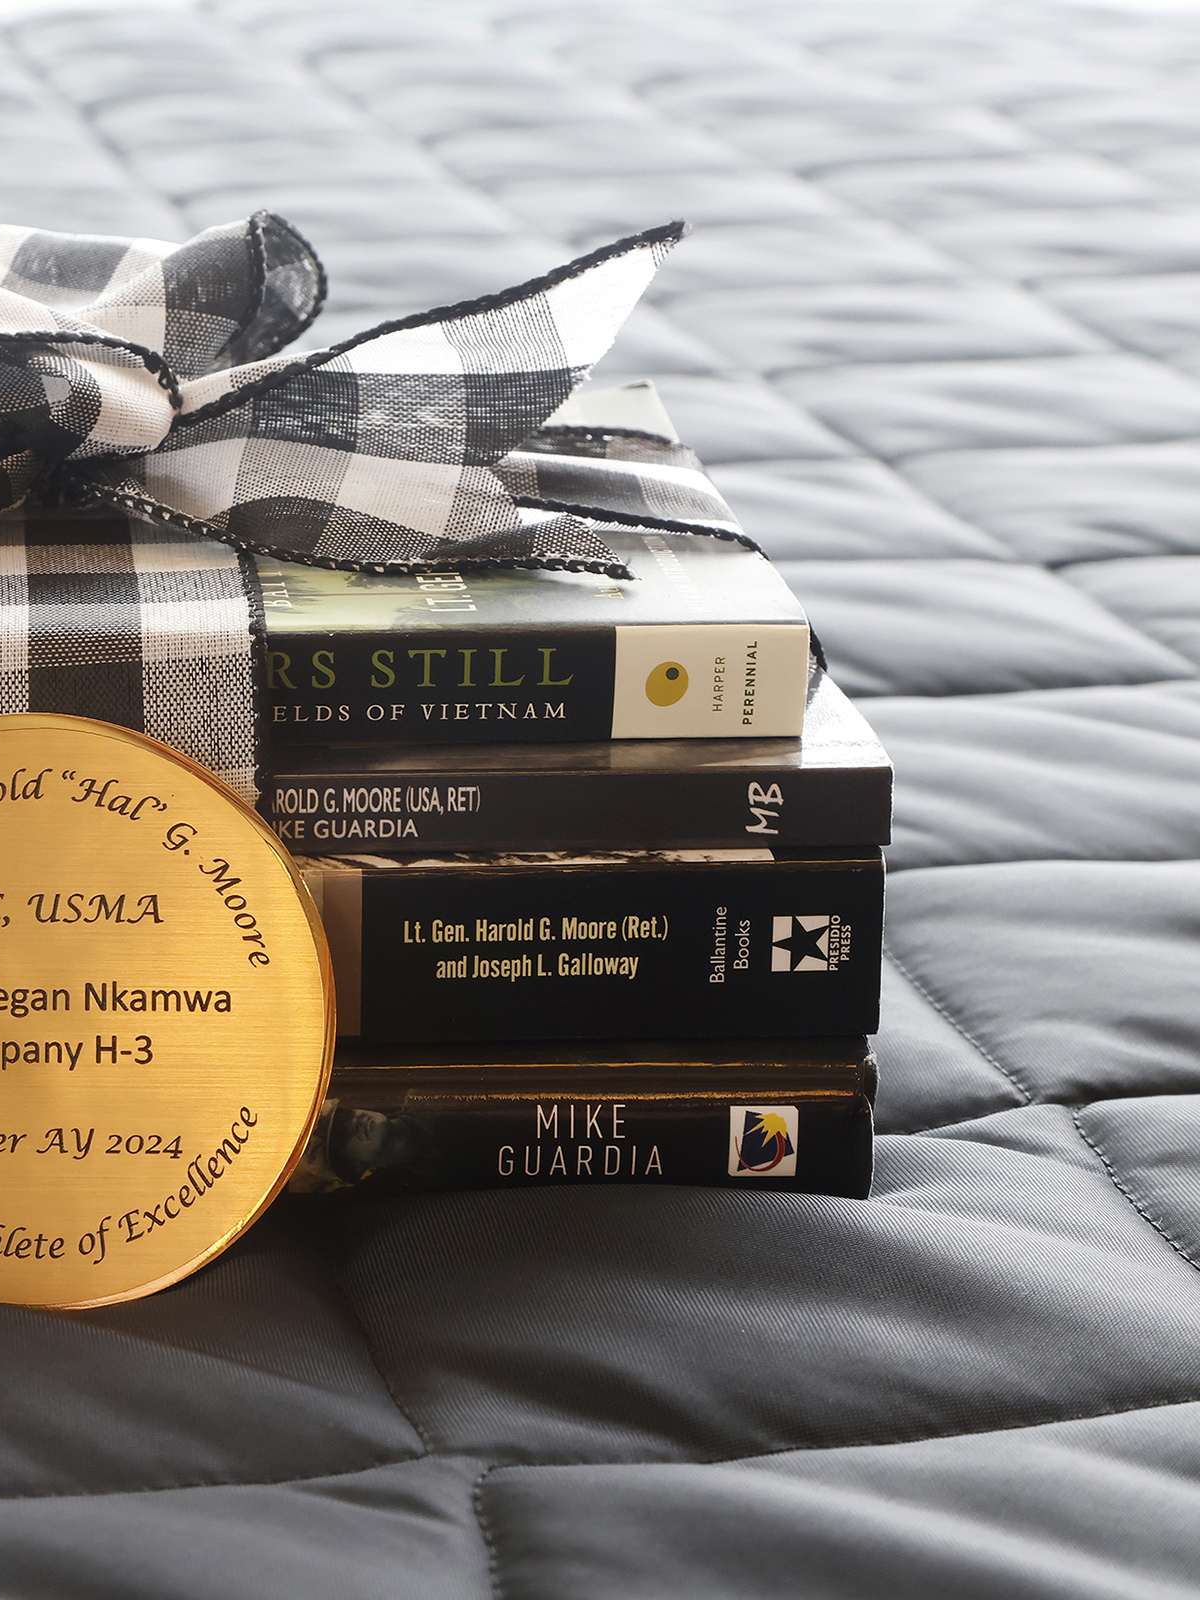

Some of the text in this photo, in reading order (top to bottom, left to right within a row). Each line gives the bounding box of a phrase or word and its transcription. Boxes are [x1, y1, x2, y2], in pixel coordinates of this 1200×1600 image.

[425, 594, 477, 612] LT.
[371, 648, 574, 688] STILL
[712, 656, 725, 713] HARPER
[742, 640, 758, 725] PERENNIAL
[273, 702, 566, 722] ELDS OF VIETNAM
[272, 785, 481, 815] ROLD G. MOORE (USA, RET)
[745, 781, 784, 835] MB
[313, 819, 418, 839] GUARDIA
[27, 893, 164, 924] USMA
[162, 822, 198, 855] G.
[199, 858, 270, 968] Moore
[403, 914, 669, 944] Lt. Gen. Harold G. Moore (Ret.)
[709, 906, 727, 983] Ballantine
[733, 919, 751, 970] Books
[829, 915, 841, 971] PRESIDIO
[840, 924, 851, 961] PRESS
[436, 953, 639, 982] and Joseph L. Galloway
[85, 981, 232, 1013] Nkamwa
[95, 1035, 154, 1065] H-3
[536, 1104, 626, 1141] MIKE
[36, 1128, 95, 1160] AY
[105, 1134, 183, 1159] 2024
[498, 1145, 664, 1177] GUARDIA
[78, 1216, 112, 1265] of
[118, 1106, 258, 1243] Excellence
